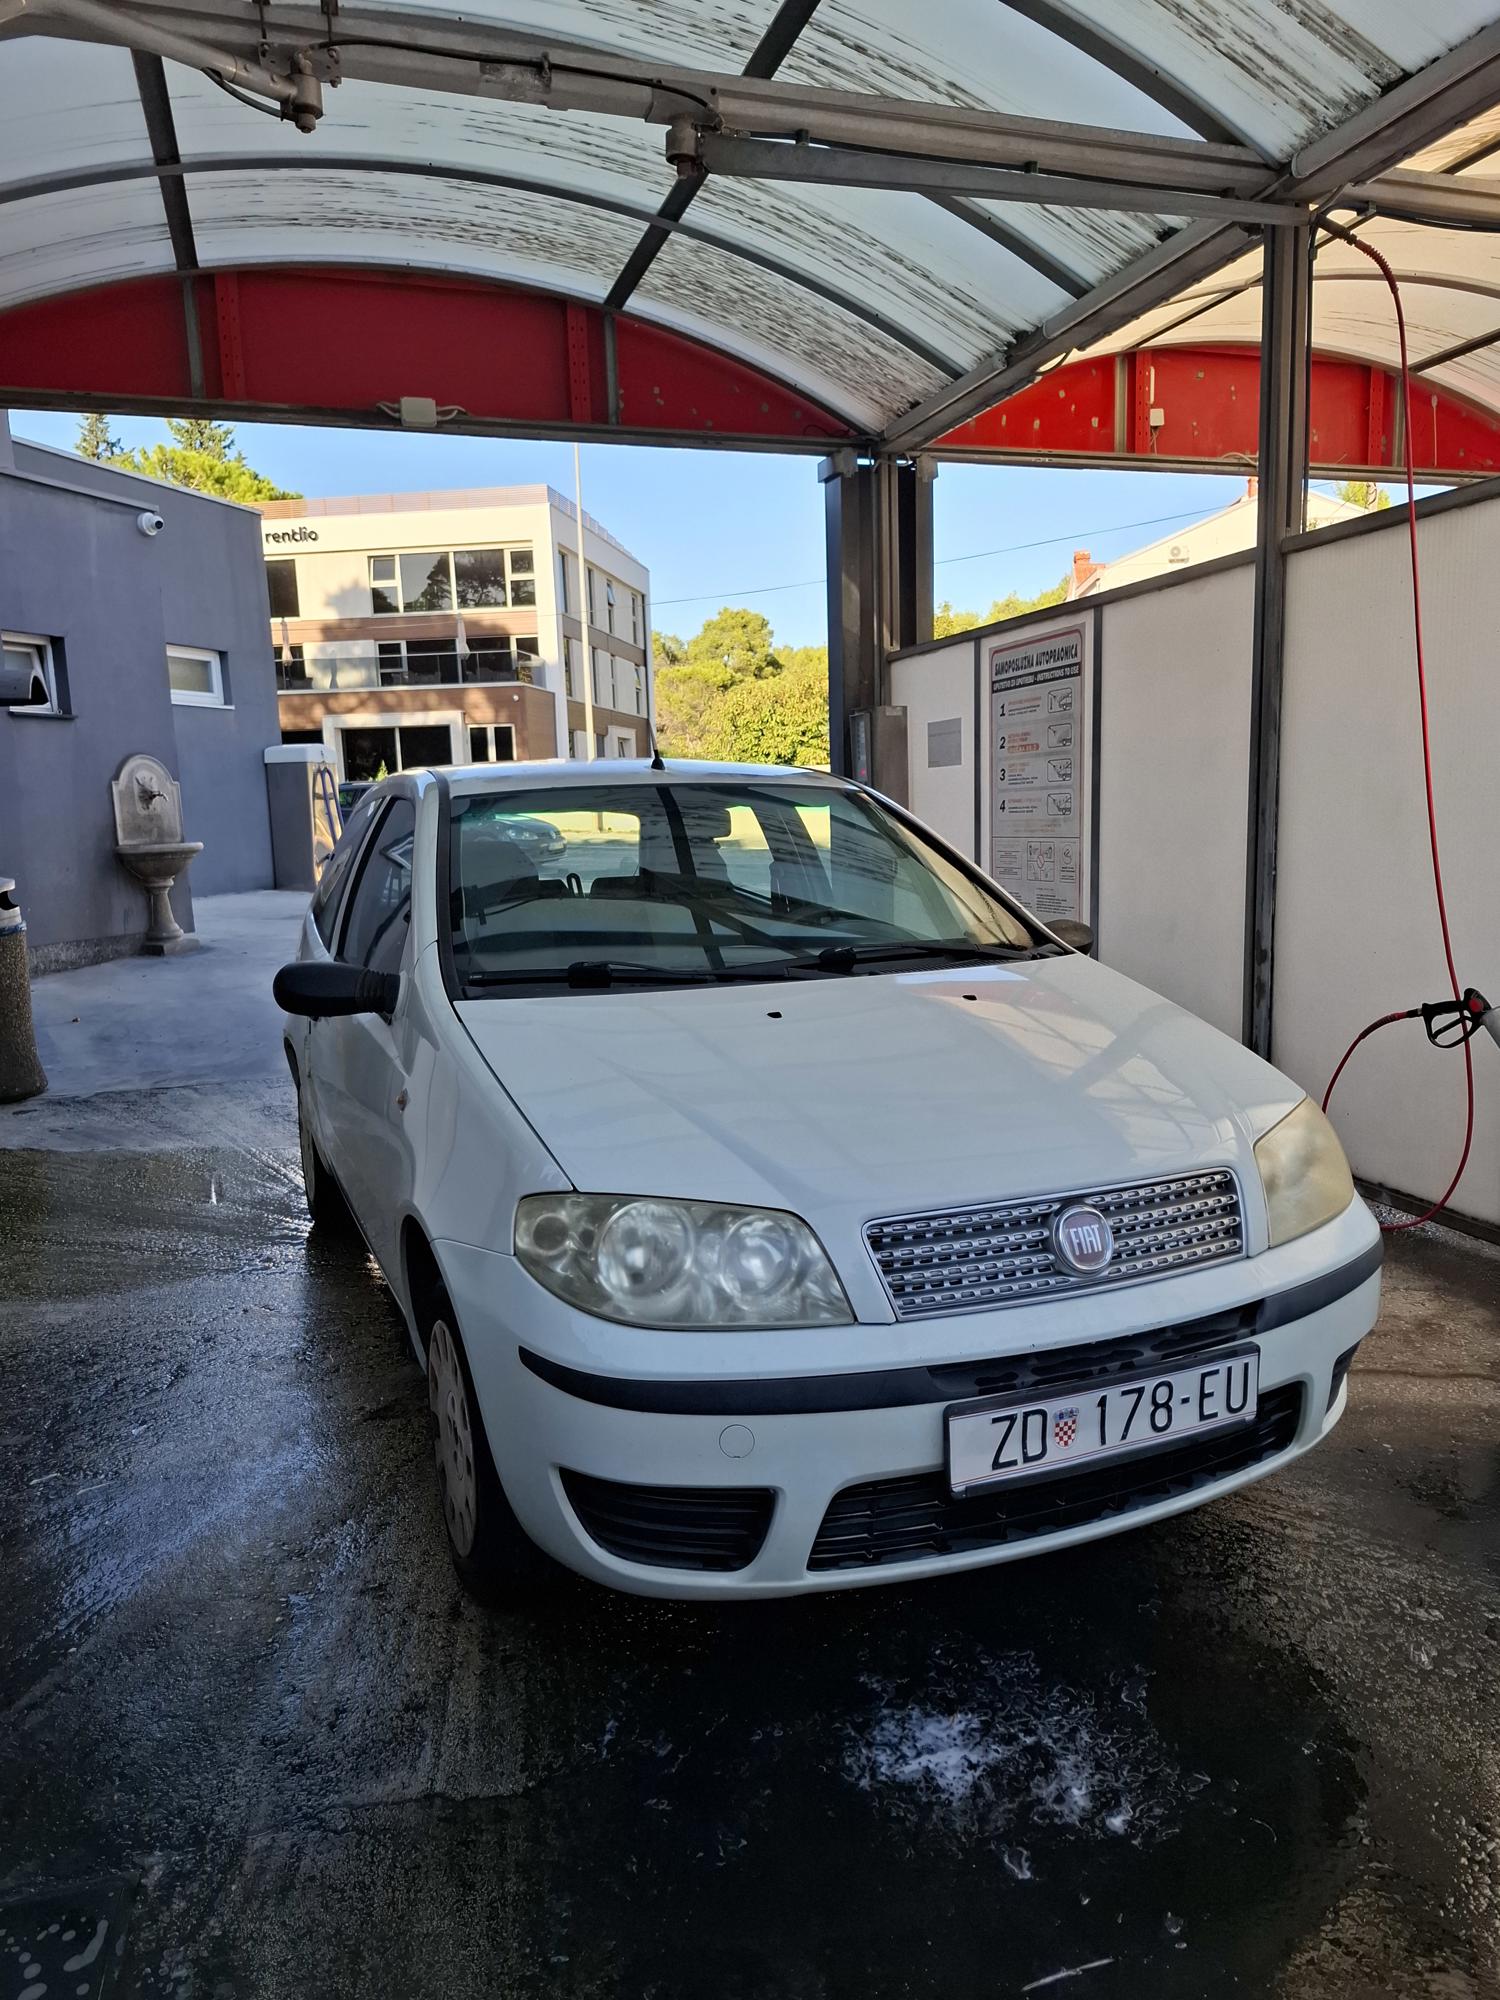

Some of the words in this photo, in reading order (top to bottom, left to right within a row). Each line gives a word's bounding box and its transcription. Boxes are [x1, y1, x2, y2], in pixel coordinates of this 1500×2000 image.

[1035, 644, 1078, 667] AUTOPRAONICA
[1000, 703, 1006, 717] 1
[1000, 736, 1006, 750] 2
[1000, 768, 1006, 781] 3
[1000, 800, 1006, 813] 4
[1069, 1224, 1102, 1256] FIAT
[991, 1407, 1048, 1471] ZD
[1097, 1361, 1250, 1446] 178-EU
